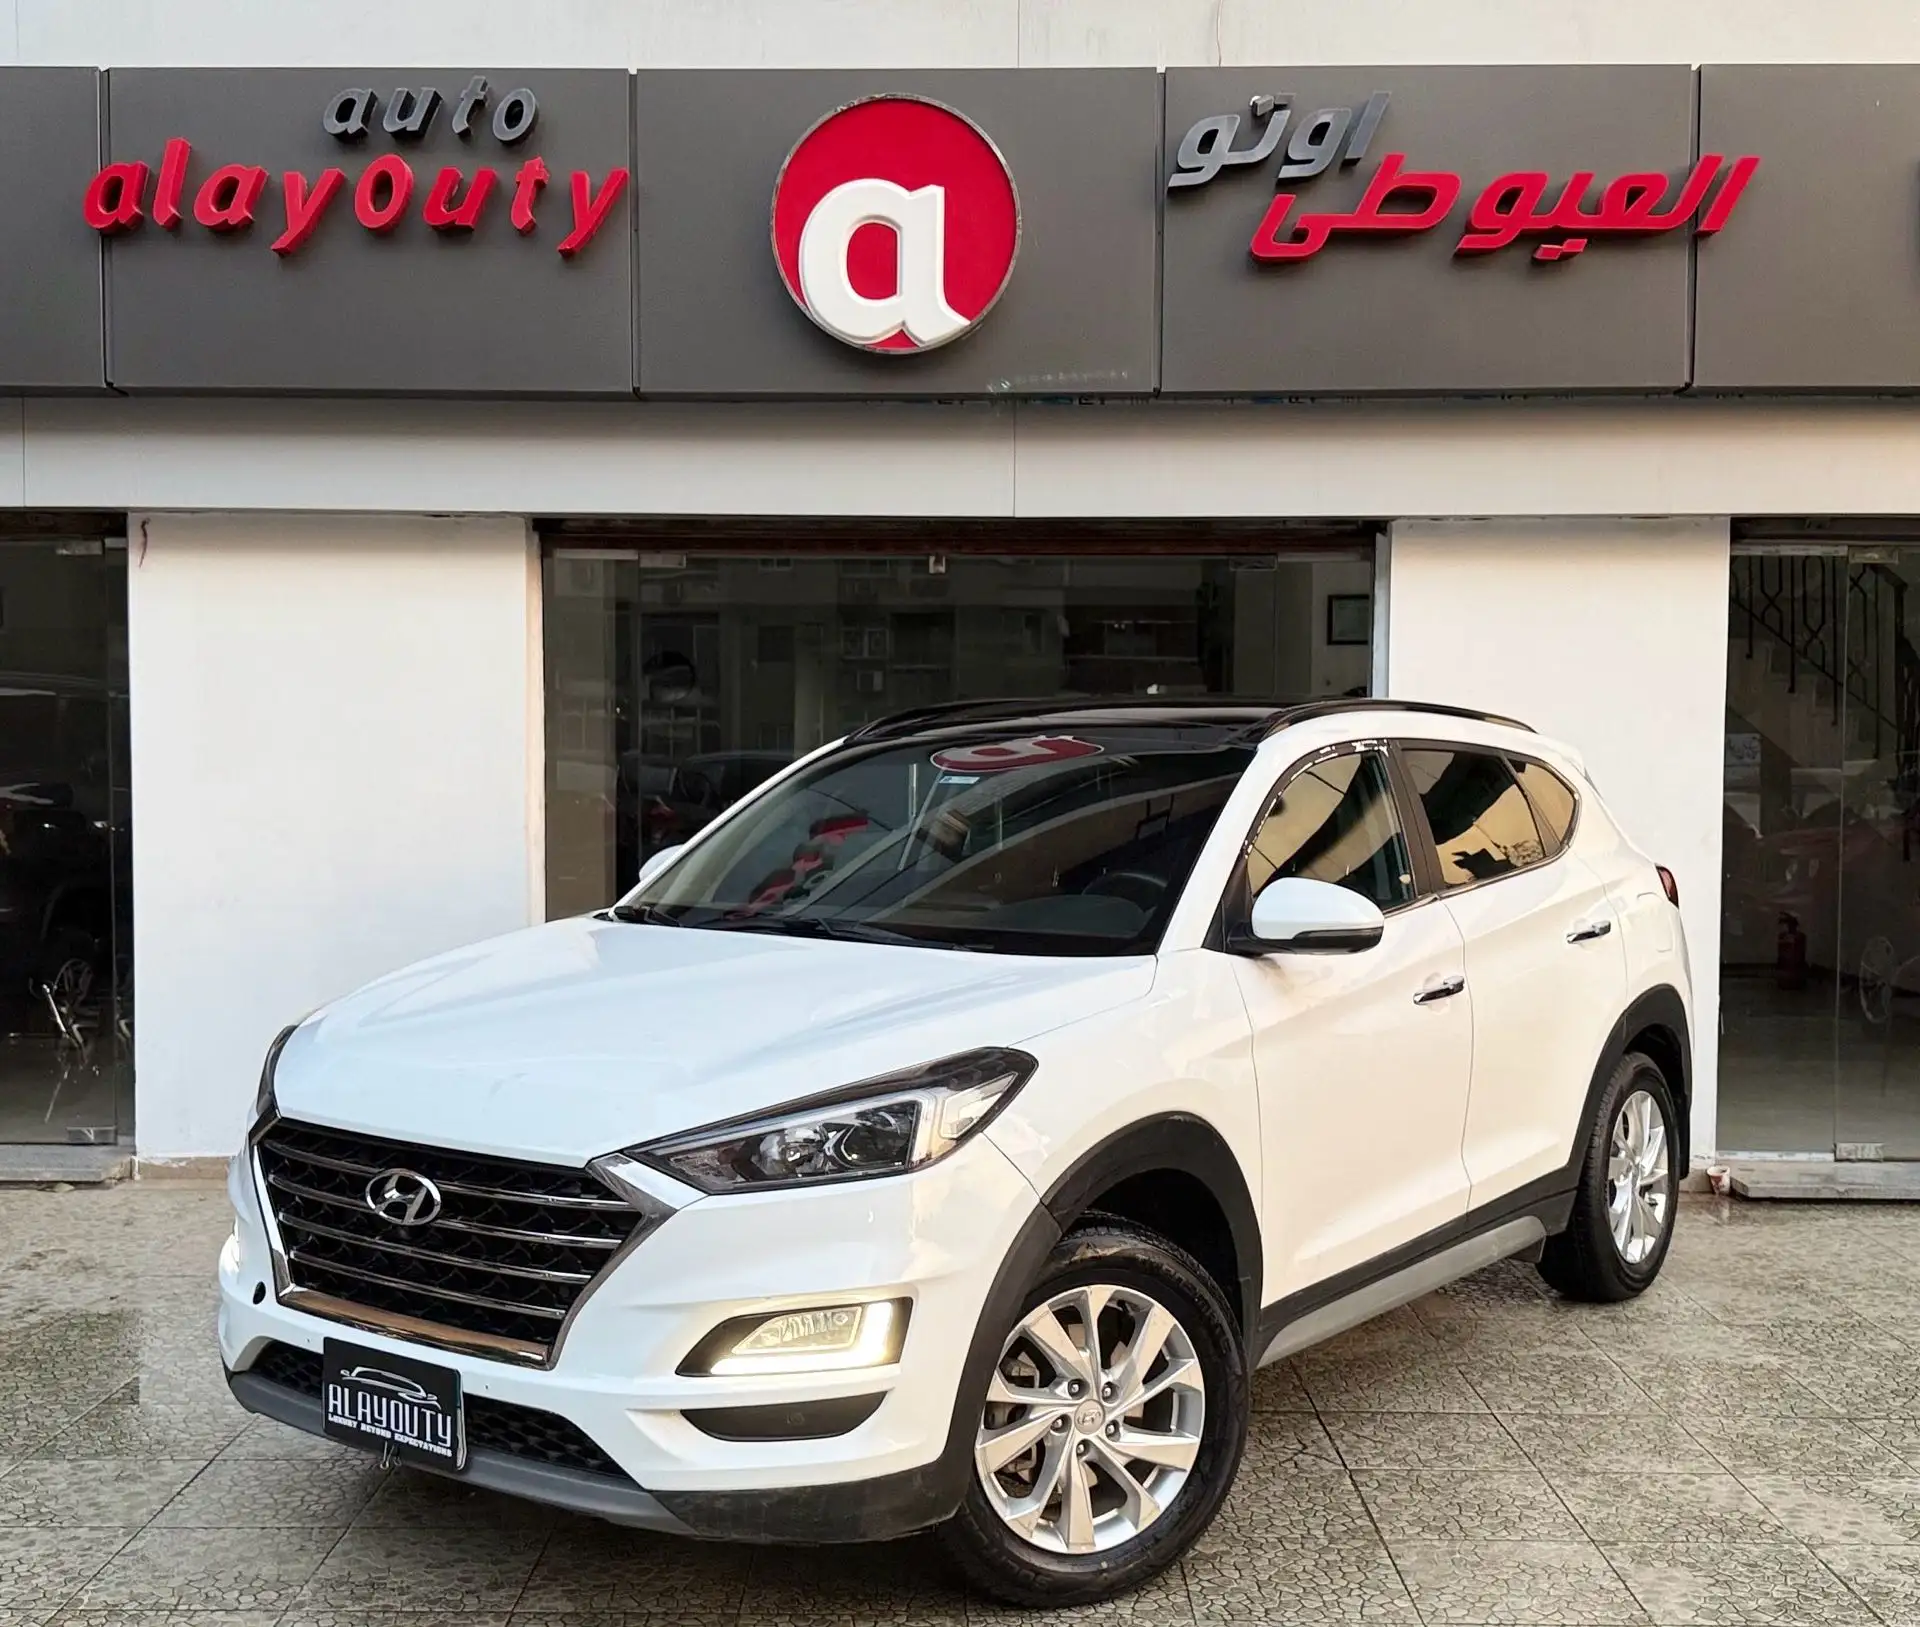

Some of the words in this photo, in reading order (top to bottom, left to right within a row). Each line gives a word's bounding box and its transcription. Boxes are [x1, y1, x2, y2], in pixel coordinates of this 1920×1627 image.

[321, 75, 540, 143] auto
[798, 177, 972, 347] a
[328, 1383, 452, 1448] ALAYOUTY
